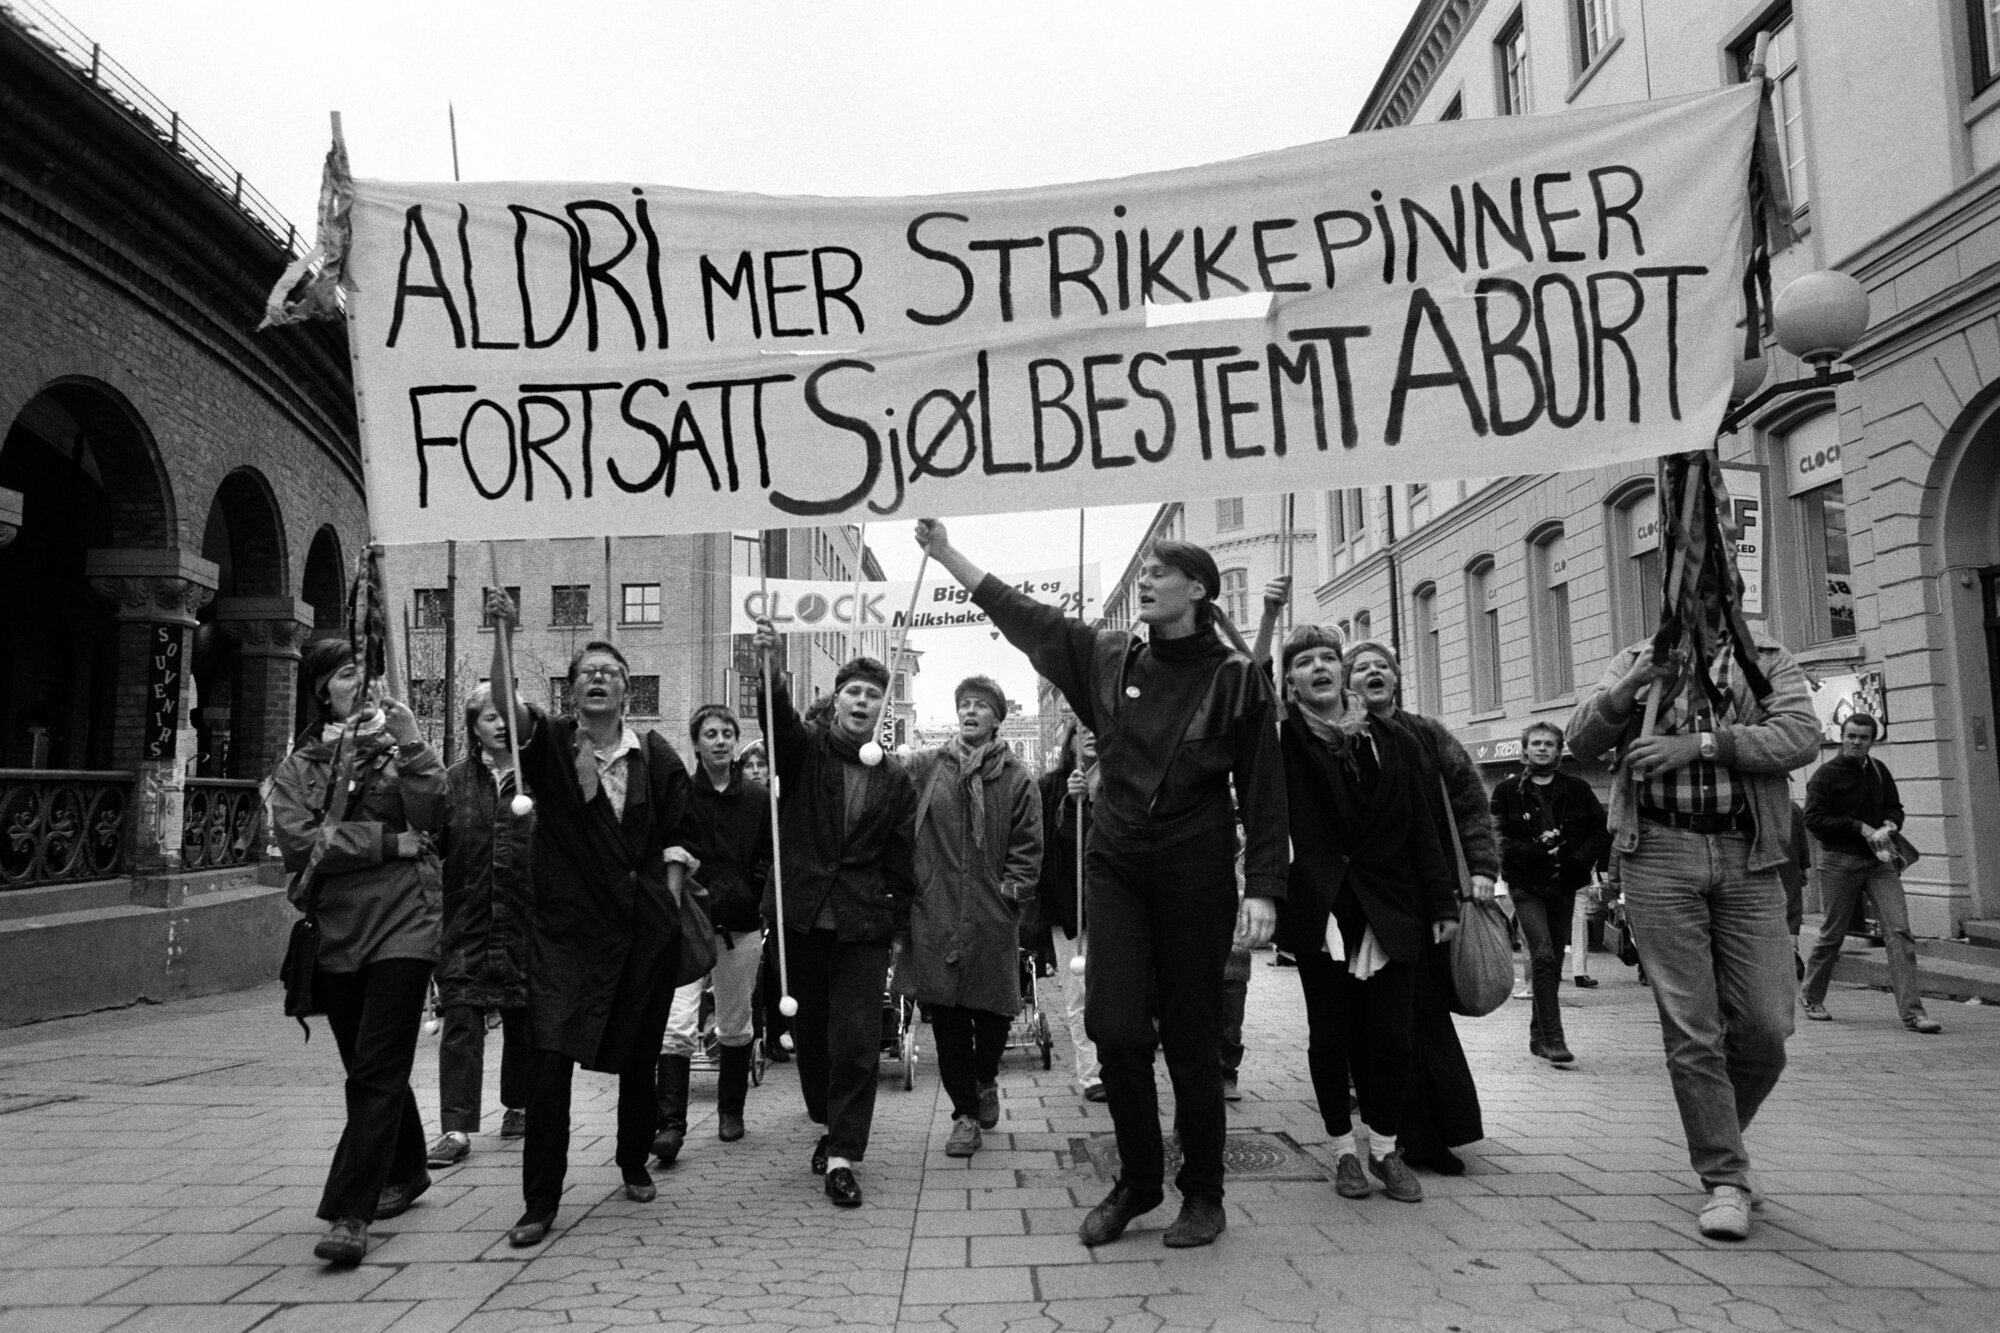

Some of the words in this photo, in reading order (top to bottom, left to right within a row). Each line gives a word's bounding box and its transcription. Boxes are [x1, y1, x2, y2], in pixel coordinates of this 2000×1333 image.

[700, 246, 865, 342] MER
[410, 374, 797, 508] FORTSATT
[1384, 266, 1709, 446] ABORT
[1734, 499, 1758, 540] F
[744, 590, 886, 624] CLOCK
[933, 585, 970, 604] Big
[1041, 581, 1061, 593] og
[892, 610, 987, 627] Milkshake
[151, 627, 178, 757] SOUVENIRS
